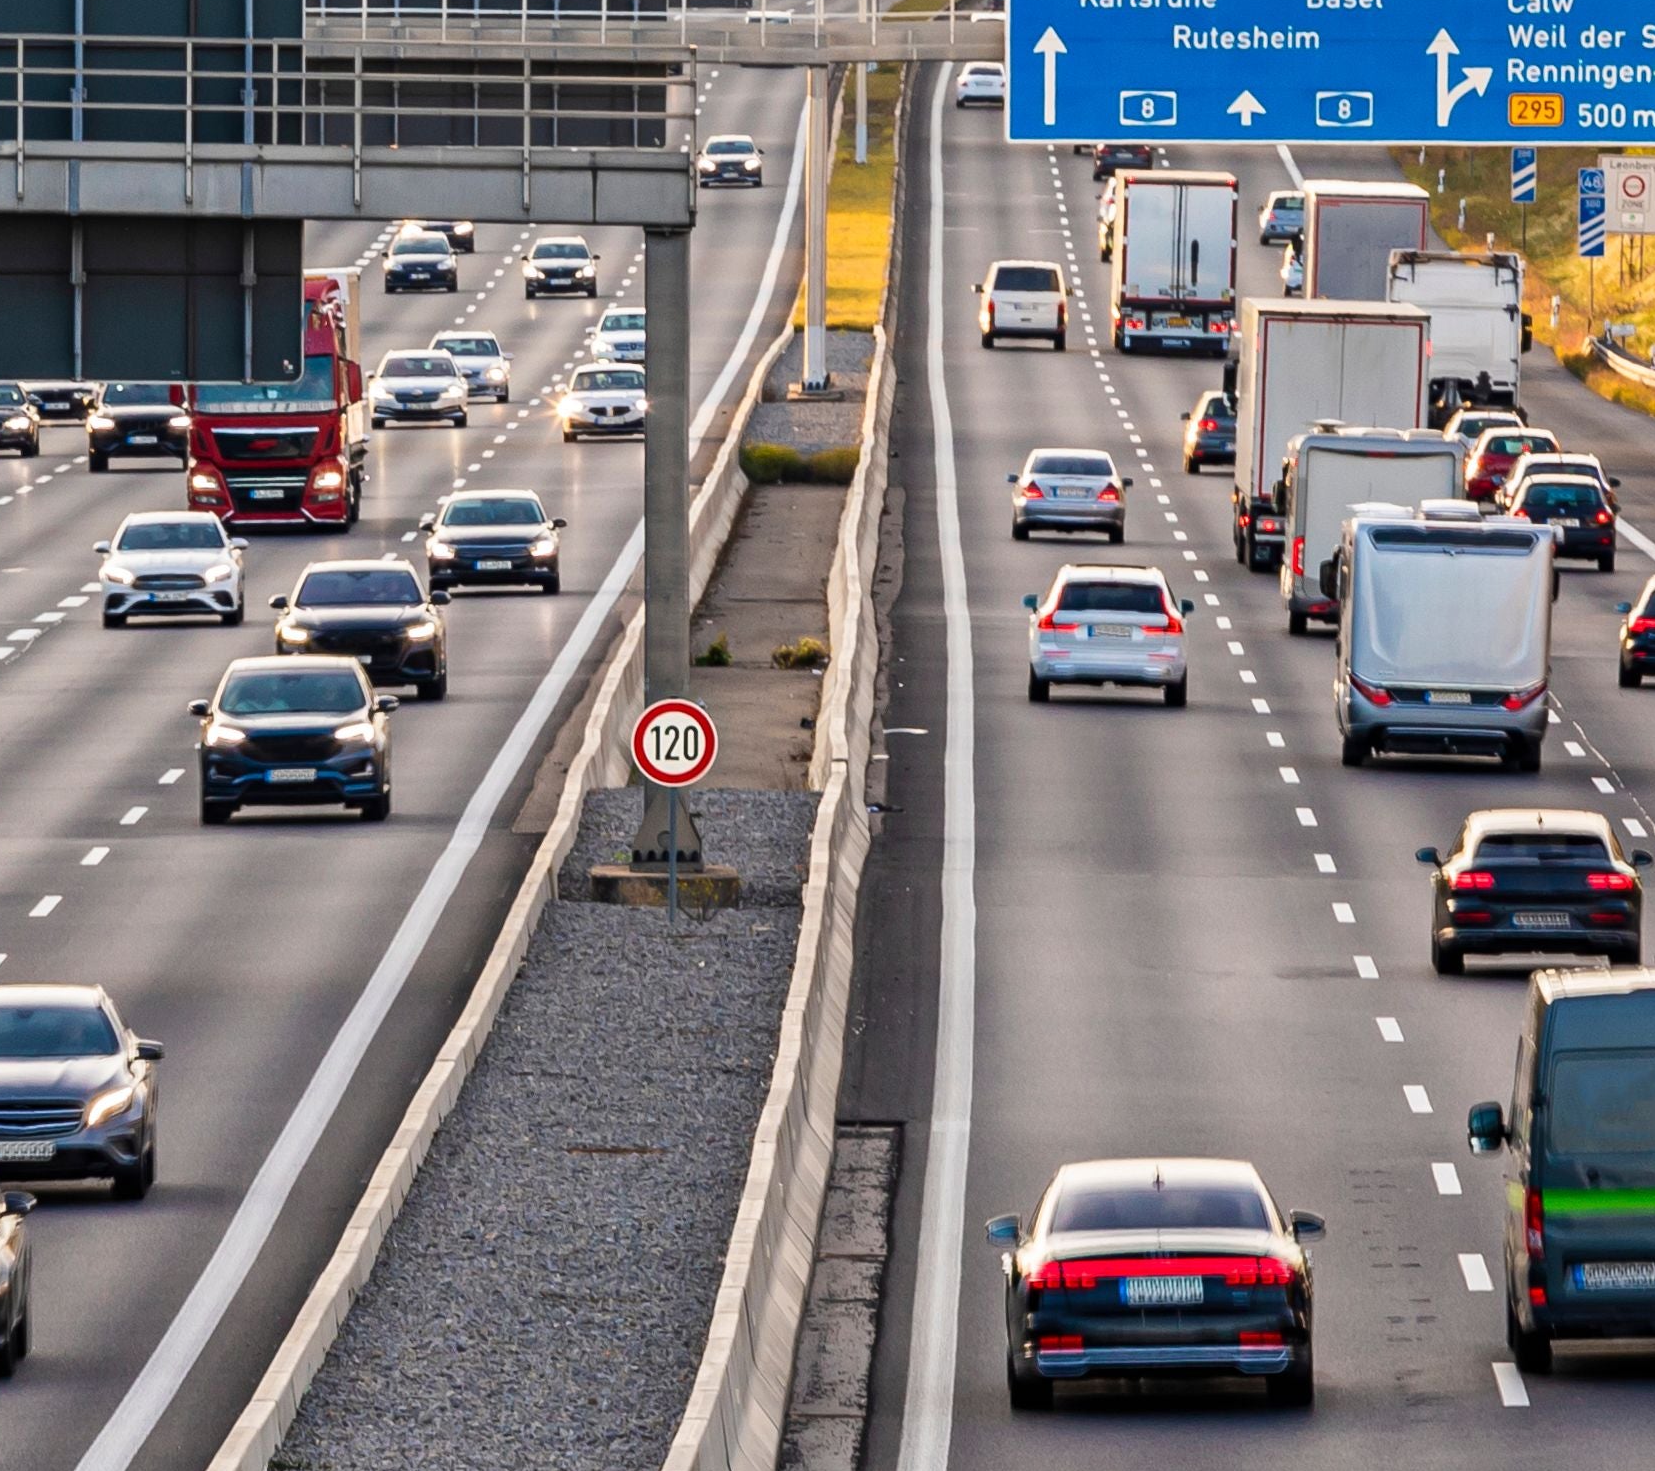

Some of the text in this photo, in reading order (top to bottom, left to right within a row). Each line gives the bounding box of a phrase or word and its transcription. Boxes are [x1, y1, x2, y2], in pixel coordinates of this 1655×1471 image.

[1173, 25, 1320, 50] Rutesheim
[1508, 24, 1567, 49] Weil
[1580, 24, 1625, 49] der
[1140, 98, 1155, 119] 8
[1337, 99, 1352, 119] 8
[1516, 100, 1556, 121] 295
[1578, 103, 1626, 128] 500
[1584, 175, 1602, 188] 48
[650, 725, 700, 762] 120
